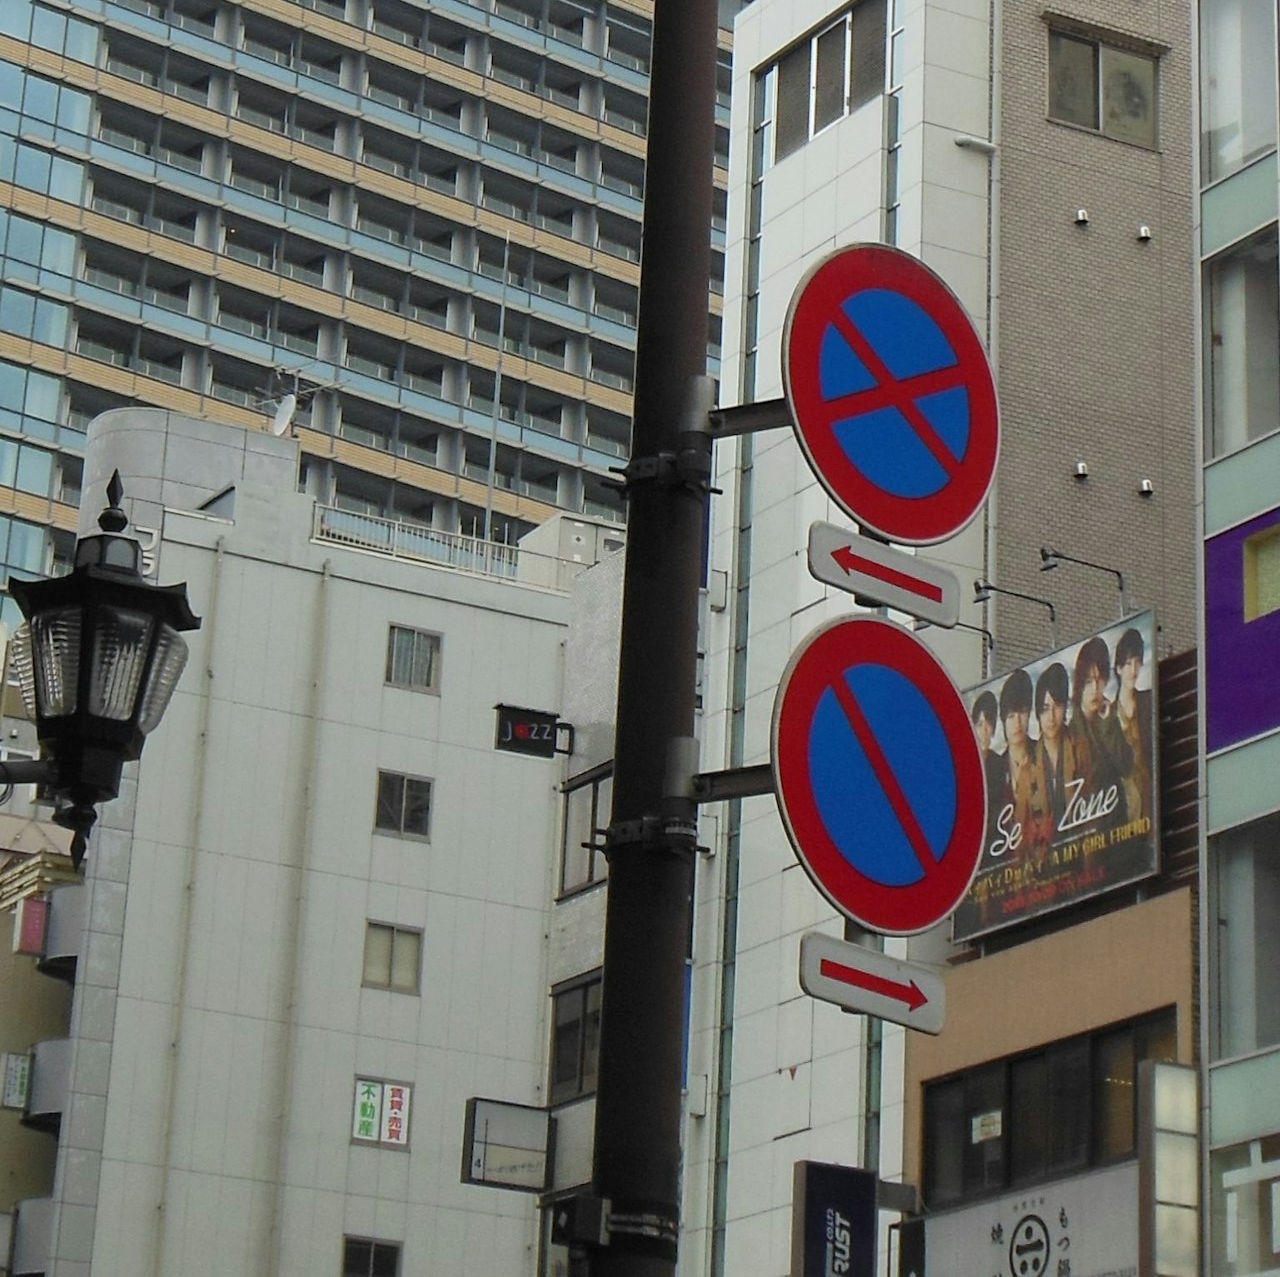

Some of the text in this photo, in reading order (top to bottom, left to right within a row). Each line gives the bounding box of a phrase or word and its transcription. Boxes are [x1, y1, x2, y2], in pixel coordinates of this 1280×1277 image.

[1057, 778, 1119, 831] Zone
[359, 1083, 377, 1137] 不動産
